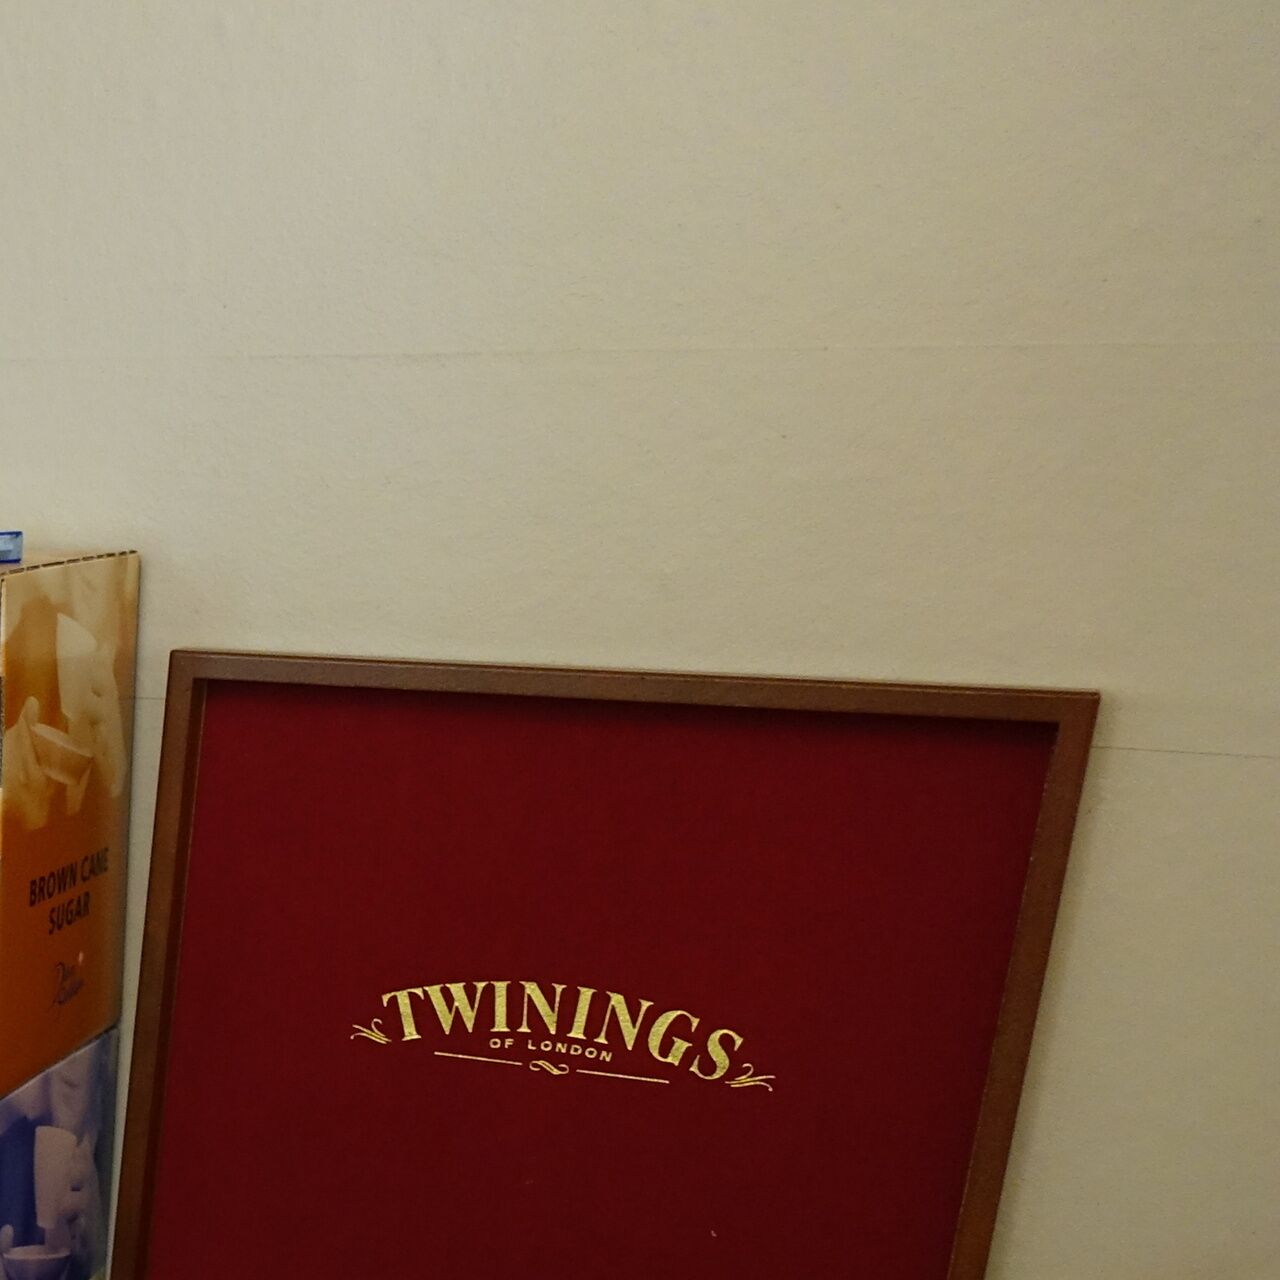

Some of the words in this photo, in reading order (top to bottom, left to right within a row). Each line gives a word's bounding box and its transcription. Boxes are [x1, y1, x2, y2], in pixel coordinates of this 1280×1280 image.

[29, 861, 78, 908] BROWN
[80, 847, 109, 883] CANE
[48, 891, 91, 935] SUGAR
[382, 980, 744, 1081] TWININGS
[489, 1038, 515, 1050] OF
[528, 1040, 614, 1063] LONDON
